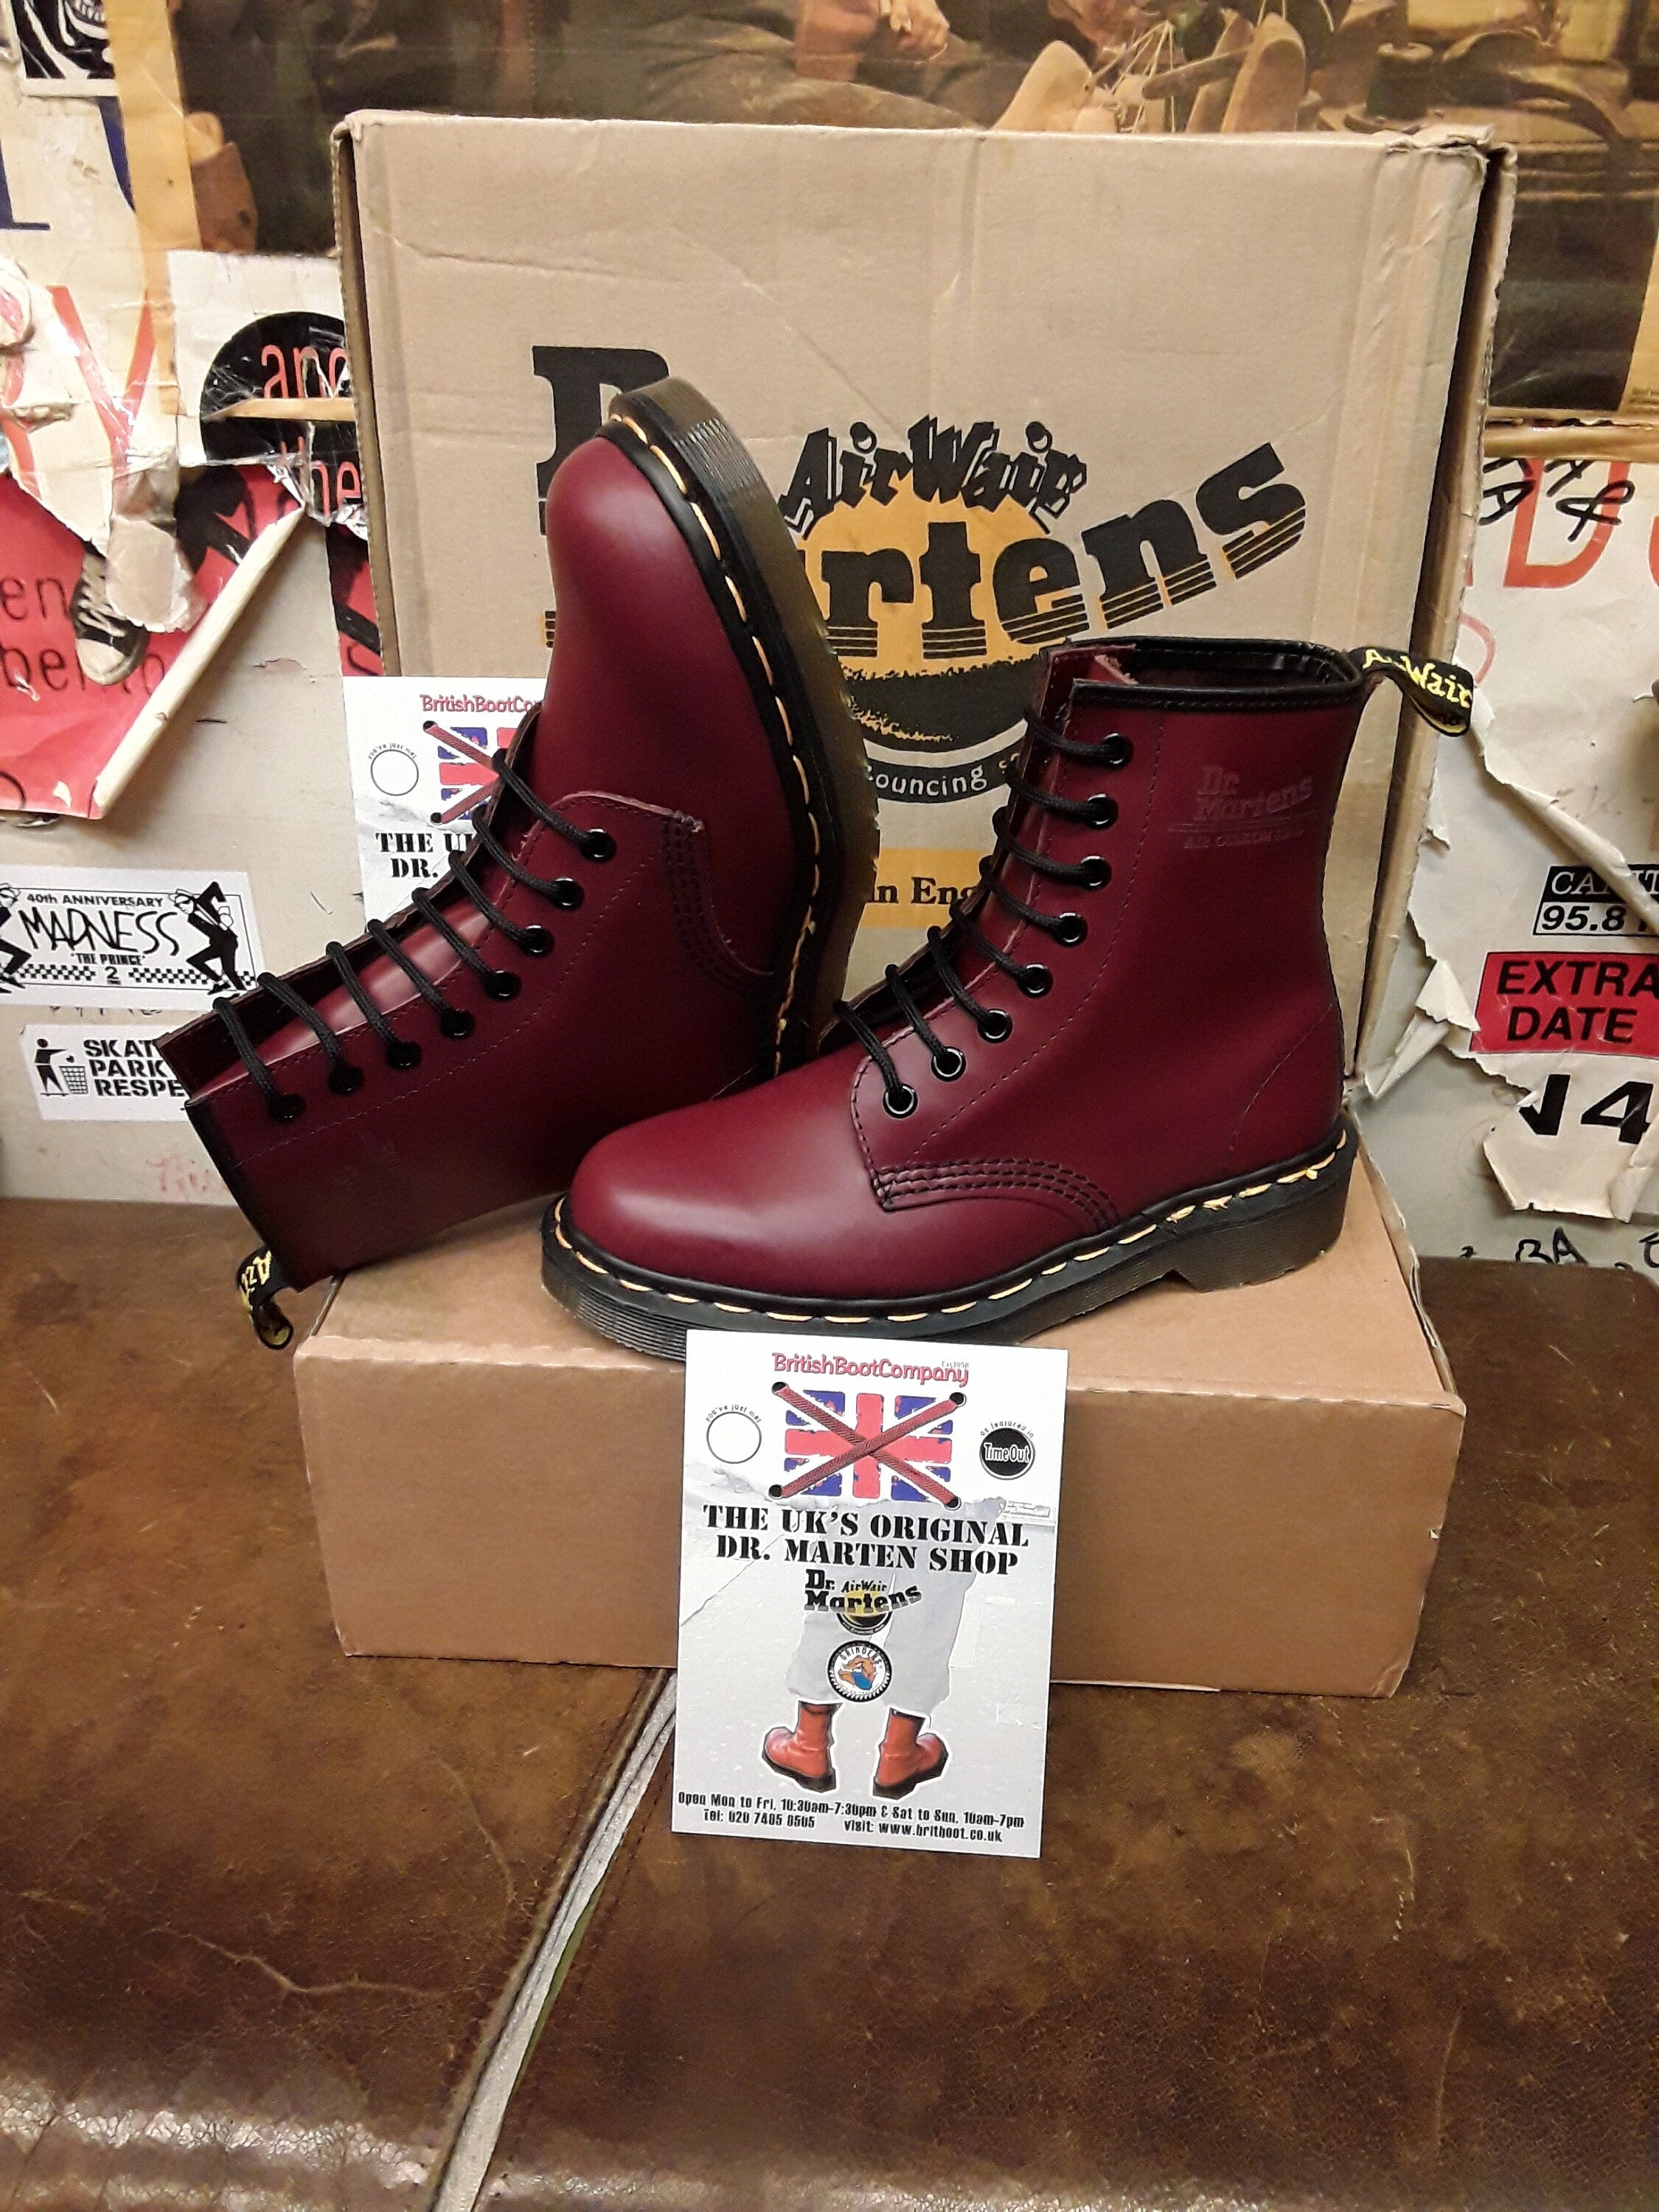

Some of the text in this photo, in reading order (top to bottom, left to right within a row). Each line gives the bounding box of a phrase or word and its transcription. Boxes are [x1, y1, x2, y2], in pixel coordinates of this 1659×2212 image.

[811, 442, 1309, 661] rtens
[420, 694, 538, 713] BritishBootCo
[867, 764, 988, 797] ouncing
[375, 832, 434, 852] THE
[390, 858, 439, 878] DR.
[27, 893, 164, 908] 40th ANNIVERSARY
[18, 906, 180, 956] MADNESS
[1541, 905, 1627, 932] 95.8
[1497, 959, 1659, 999] EXTRA
[1507, 1006, 1638, 1043] DATE
[83, 1039, 159, 1058] SKAT
[89, 1059, 169, 1078] PARK
[94, 1079, 186, 1097] RESPE
[772, 1352, 970, 1388] BritishBootCompany
[703, 1504, 1029, 1547] THE UK'S ORIGINAL
[715, 1534, 1019, 1575] DR. MARTEN SHOP
[805, 1568, 888, 1593] Dr. AirWair
[804, 1585, 922, 1613] Martens
[678, 1791, 706, 1806] Open
[711, 1793, 736, 1807] Mon
[740, 1796, 752, 1809] to
[892, 1806, 913, 1820] Sat
[918, 1808, 931, 1821] to
[703, 1808, 724, 1822] Tel:
[728, 1811, 750, 1824] 020
